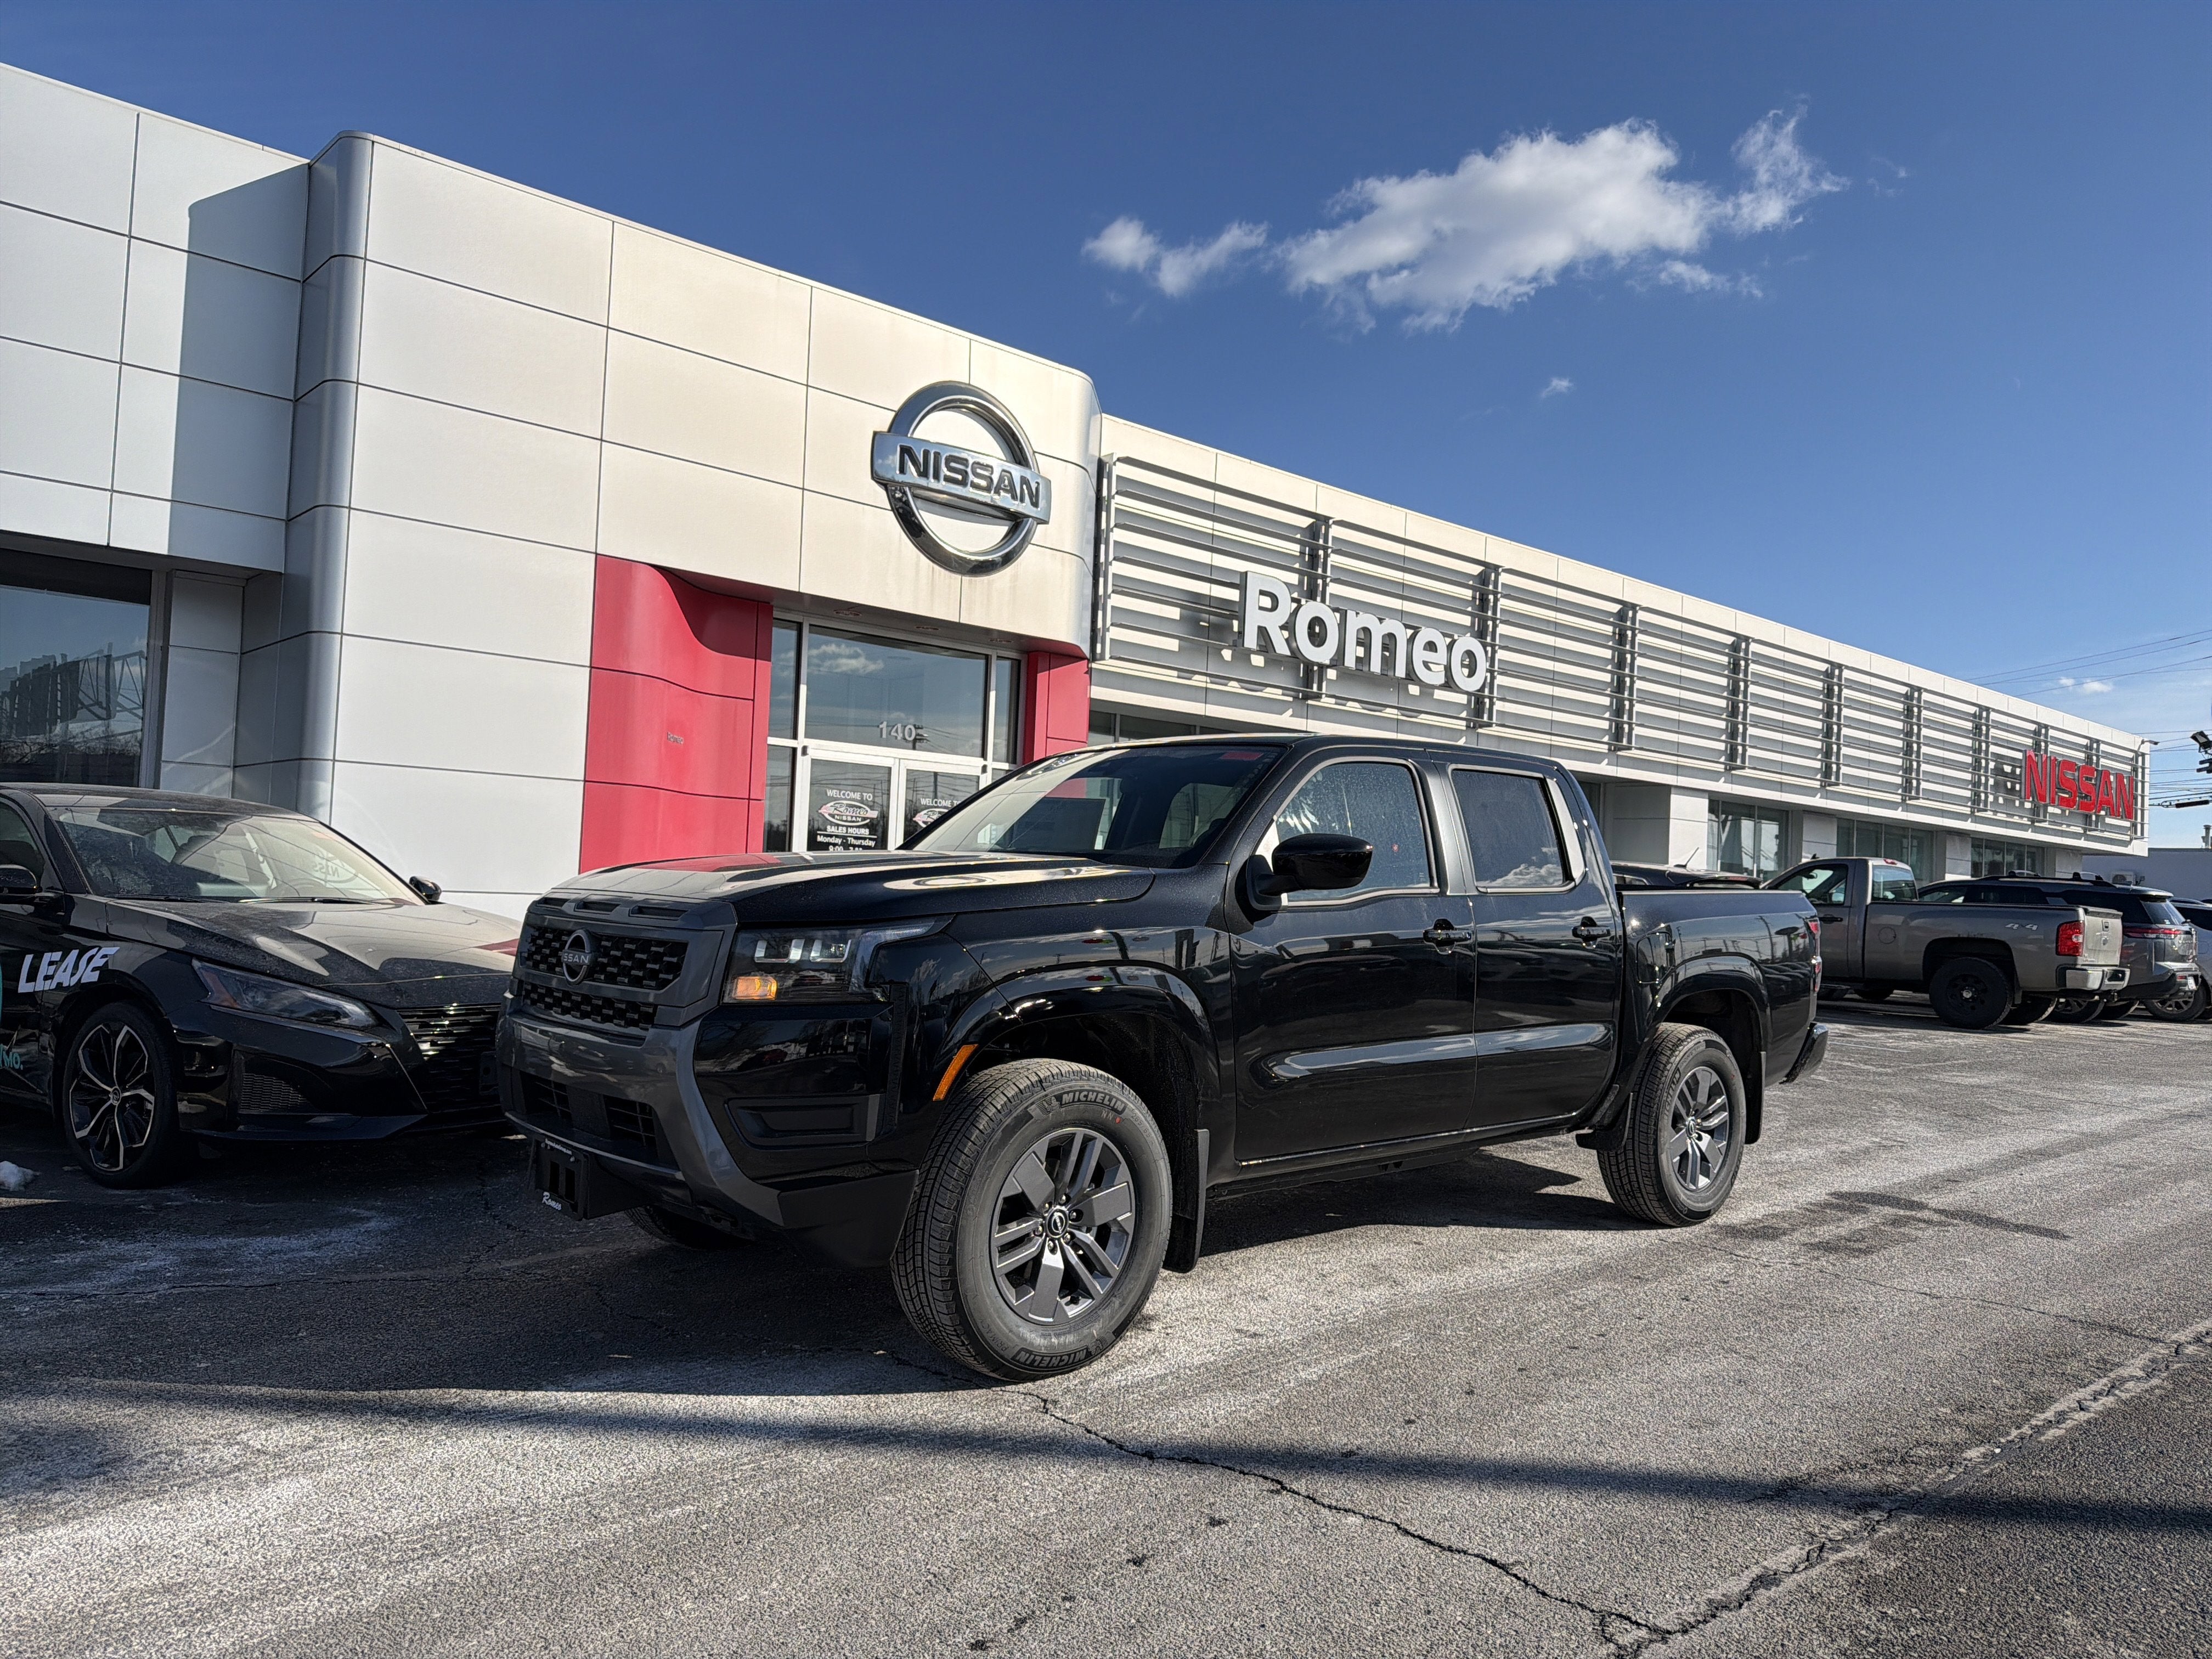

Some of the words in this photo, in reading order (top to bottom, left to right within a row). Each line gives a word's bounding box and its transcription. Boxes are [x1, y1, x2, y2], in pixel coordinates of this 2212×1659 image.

[896, 443, 1041, 510] NISSAN
[1239, 571, 1486, 692] Romeo
[879, 721, 916, 741] 140
[2023, 749, 2134, 820] NISSAN
[827, 789, 861, 800] WELCOME
[862, 793, 873, 801] TO
[921, 798, 952, 807] WELCOME
[830, 802, 868, 815] Romeo
[826, 825, 847, 833] SALES
[848, 827, 870, 835] HOURS
[817, 834, 842, 845] Monday
[847, 837, 876, 847] Thursday
[563, 953, 589, 963] SSAN
[18, 947, 120, 993] LEASE
[1062, 1091, 1125, 1111] MICHELIN
[1015, 1349, 1087, 1367] MICHELIN
